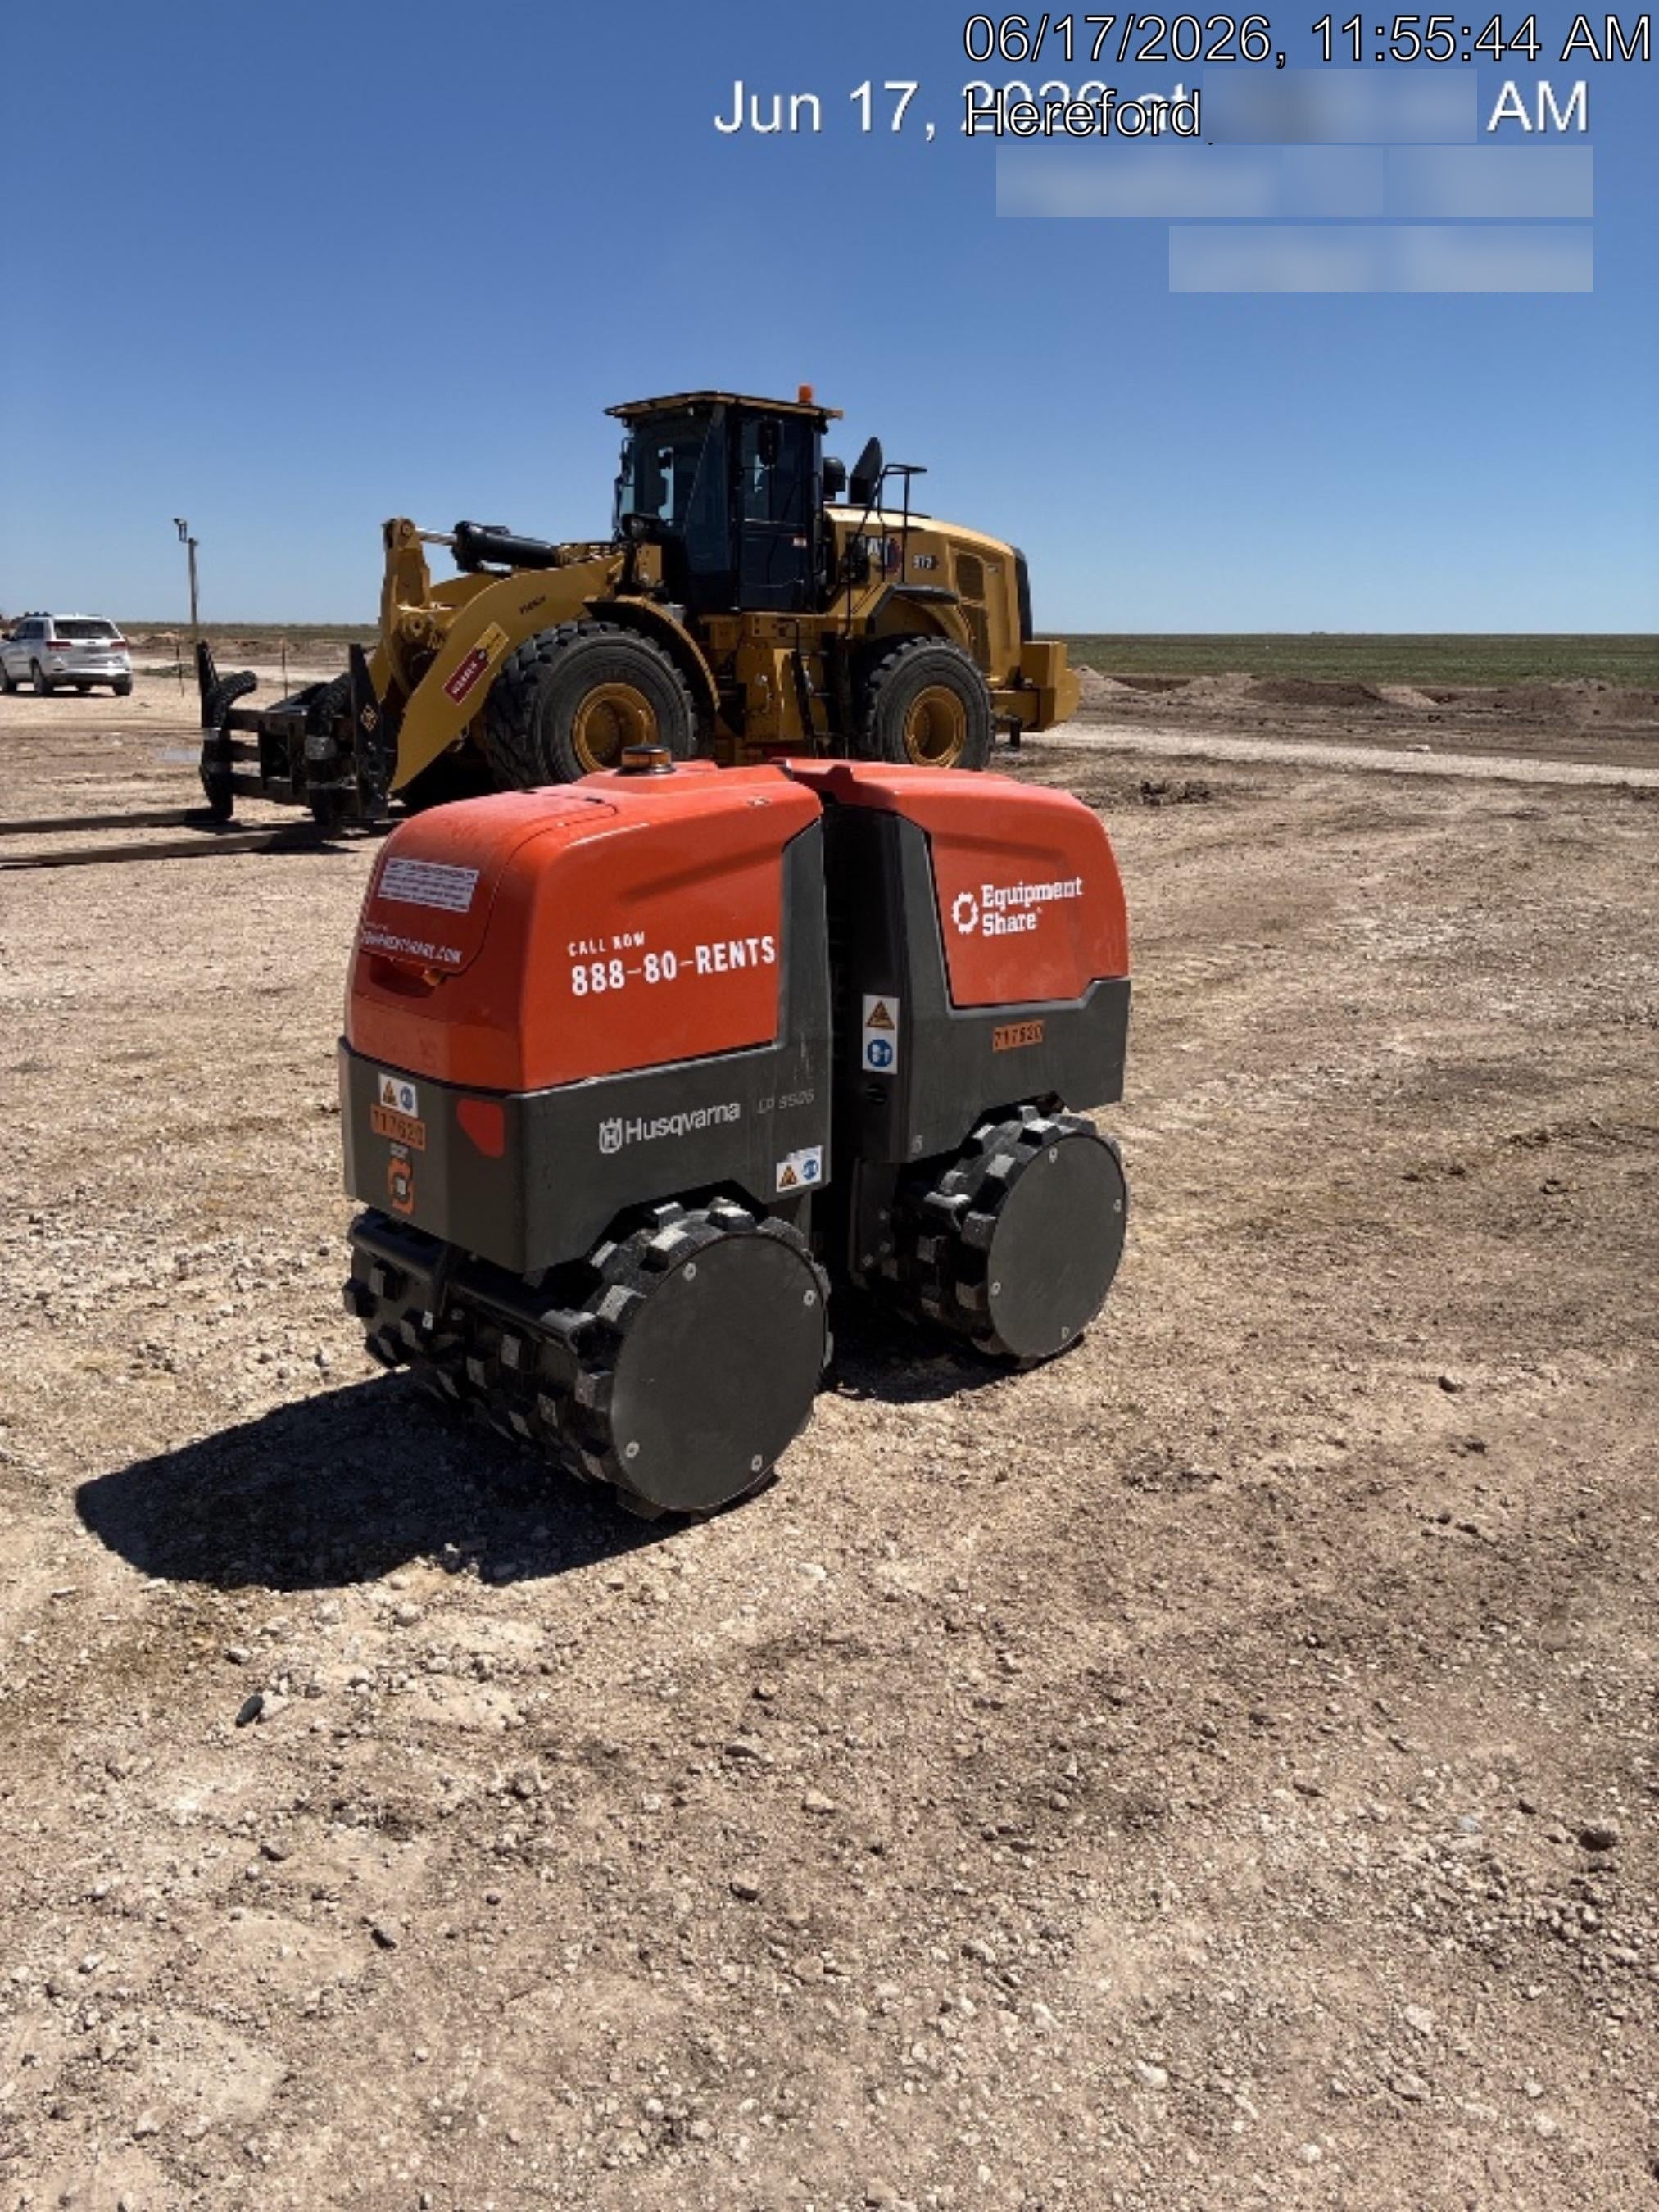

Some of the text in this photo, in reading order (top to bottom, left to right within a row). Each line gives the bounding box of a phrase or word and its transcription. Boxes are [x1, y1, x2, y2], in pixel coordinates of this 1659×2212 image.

[981, 877, 1084, 912] Equipment
[982, 912, 1037, 937] Share
[568, 931, 646, 957] CALL NOW
[572, 935, 776, 996] 888-80-RENTS
[625, 1103, 741, 1144] Husqvarna
